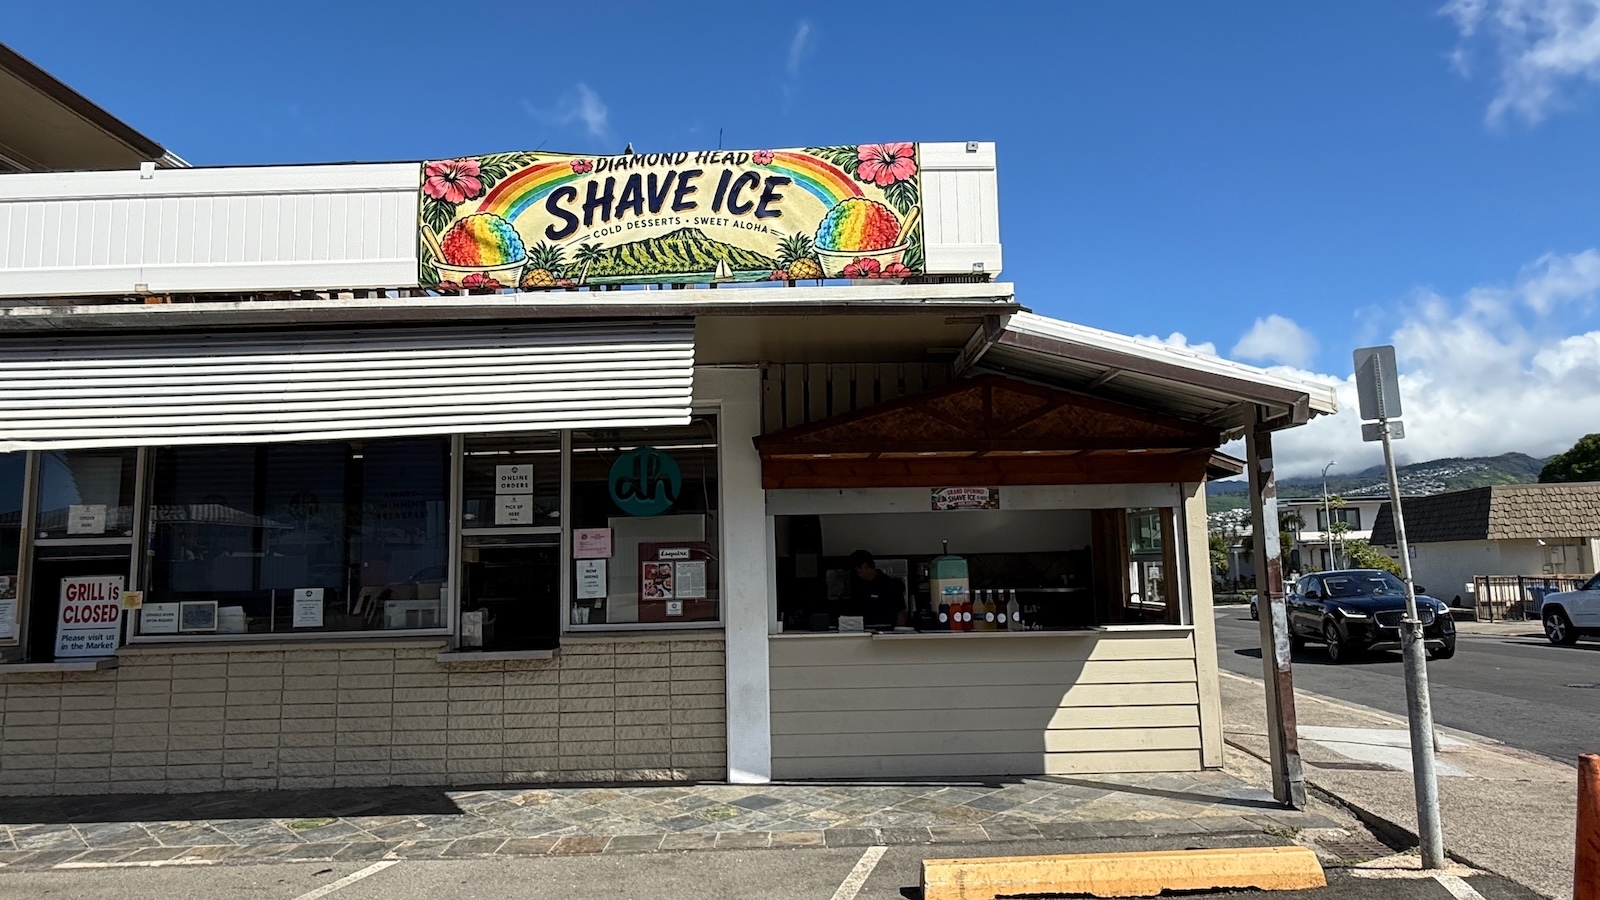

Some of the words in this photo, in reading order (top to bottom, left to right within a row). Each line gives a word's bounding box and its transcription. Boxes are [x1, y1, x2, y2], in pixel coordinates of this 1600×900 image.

[594, 152, 688, 173] DIAMOND
[694, 151, 750, 166] HEAD
[544, 169, 704, 241] SHAVE
[711, 169, 792, 219] ICE
[593, 225, 622, 239] COLD
[627, 217, 681, 230] DESSERTS
[694, 217, 730, 227] SWEET
[732, 220, 768, 234] ALOHA
[947, 495, 966, 503] SHAVE
[66, 583, 104, 601] GRILL
[108, 582, 119, 601] is
[63, 604, 119, 624] CLOSED
[61, 642, 68, 650] in
[71, 642, 84, 650] the
[86, 642, 113, 650] Market
[88, 633, 103, 641] visit
